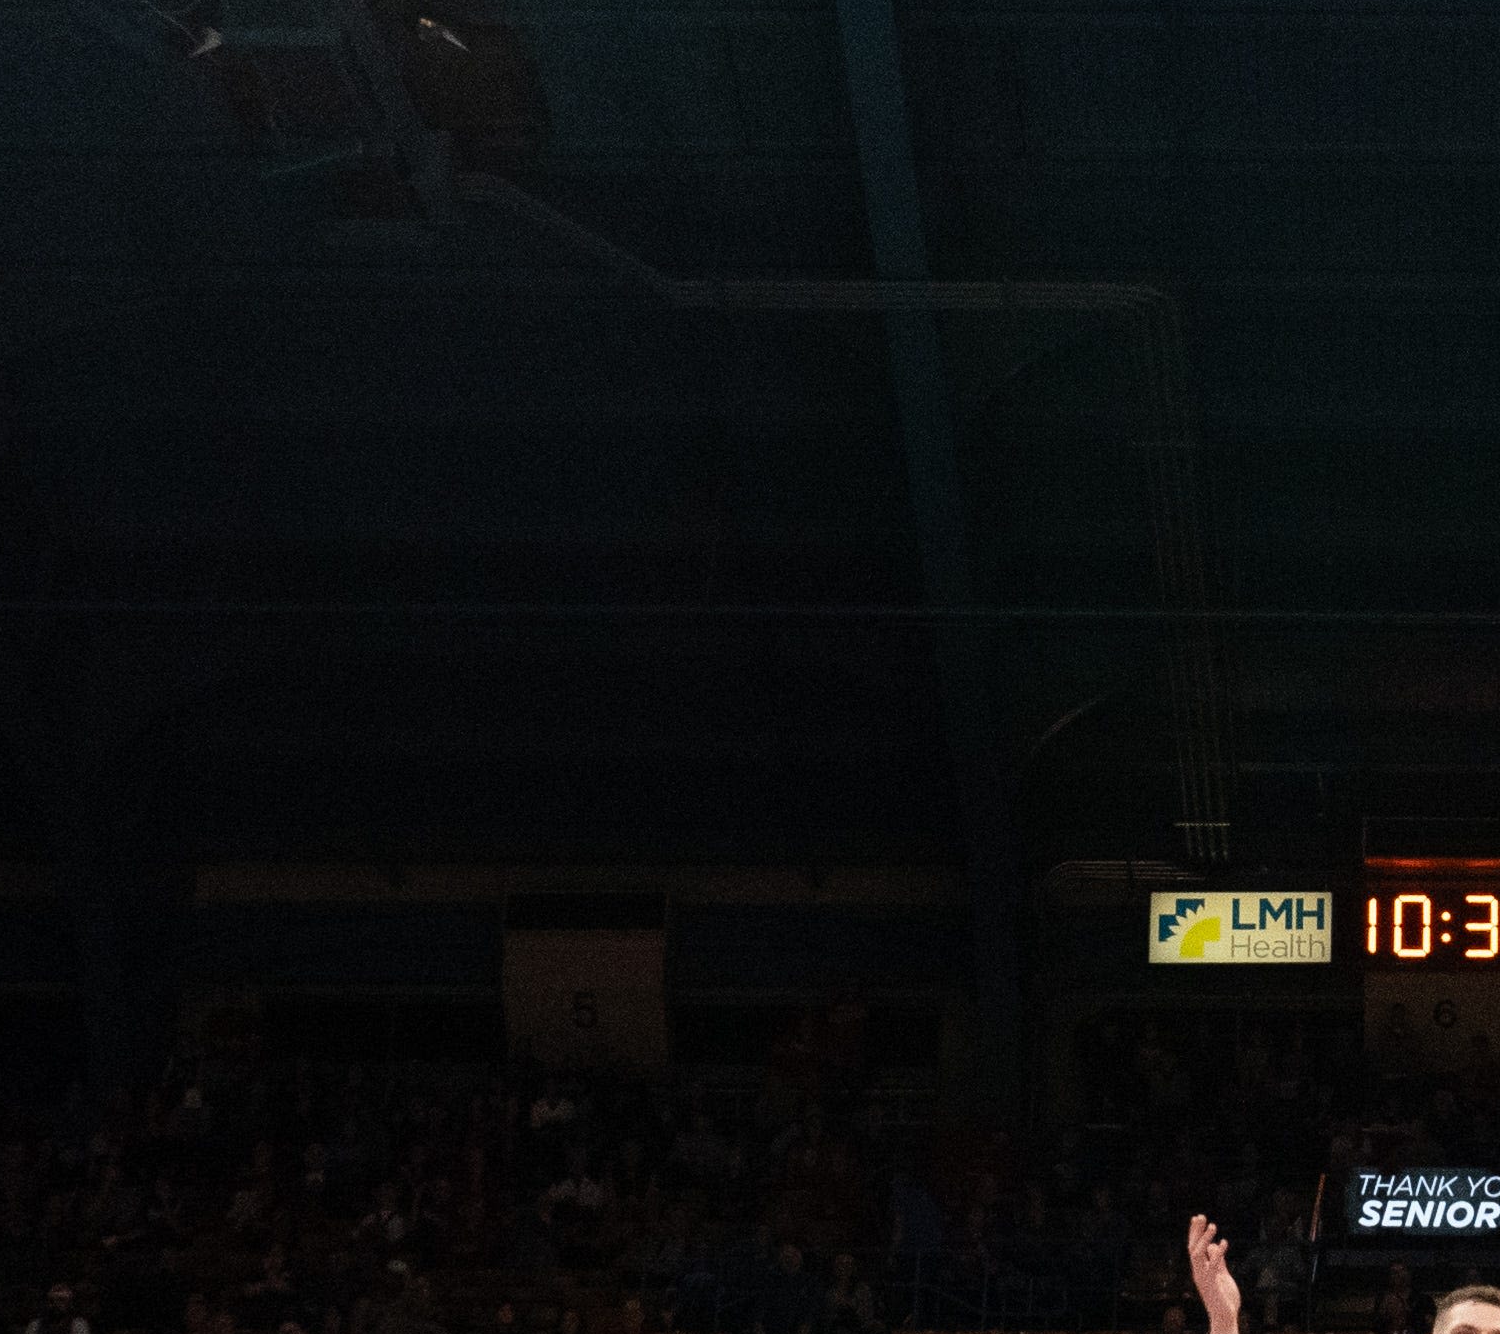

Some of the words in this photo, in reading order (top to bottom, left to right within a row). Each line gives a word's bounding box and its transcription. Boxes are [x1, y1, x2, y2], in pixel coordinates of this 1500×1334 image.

[1232, 898, 1325, 931] LMH
[1230, 935, 1326, 959] Health
[1432, 999, 1457, 1028] 6
[1360, 1174, 1458, 1197] THANK
